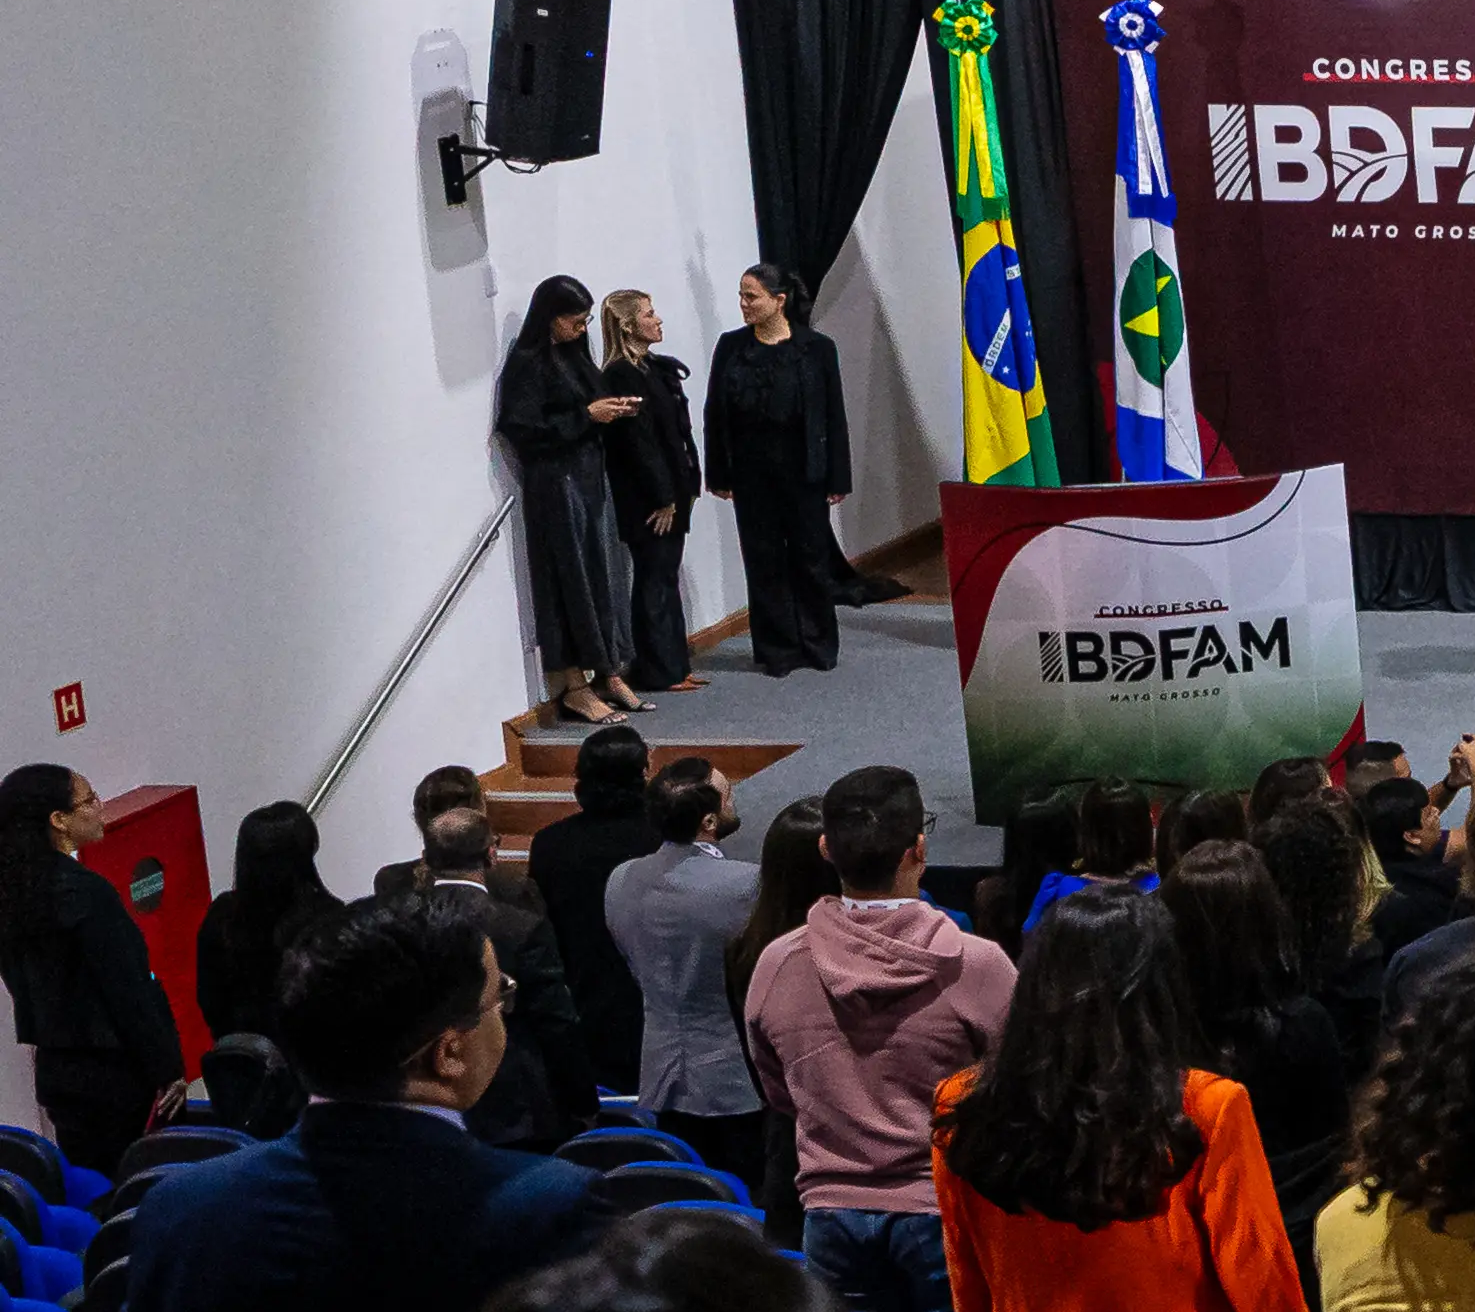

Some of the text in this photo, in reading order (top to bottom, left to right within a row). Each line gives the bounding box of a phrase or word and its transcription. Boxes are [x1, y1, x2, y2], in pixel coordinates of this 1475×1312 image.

[1331, 223, 1400, 239] MATO
[984, 323, 1009, 368] ORDEM
[1099, 598, 1223, 617] CONGRESSO
[1037, 616, 1292, 684] IBDFAM
[60, 690, 80, 723] H
[1109, 687, 1221, 703] MATO GROSSO
